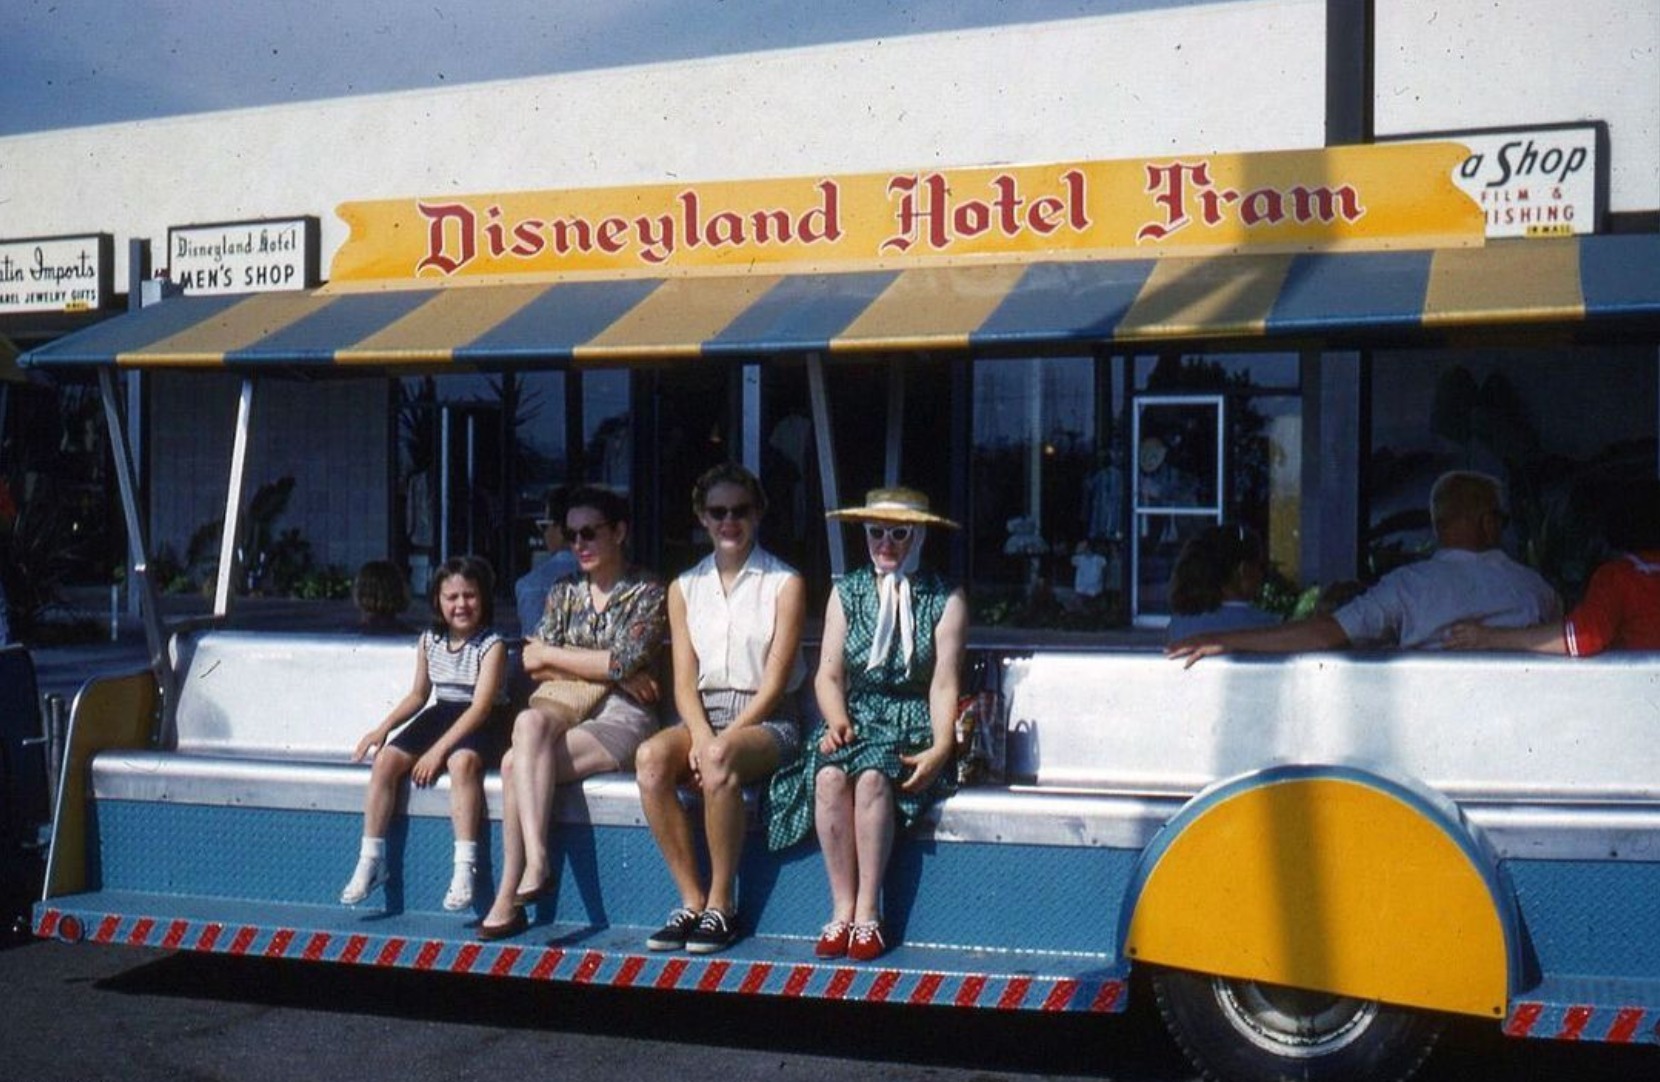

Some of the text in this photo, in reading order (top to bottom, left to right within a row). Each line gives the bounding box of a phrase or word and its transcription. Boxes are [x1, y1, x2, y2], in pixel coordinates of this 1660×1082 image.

[1486, 140, 1588, 187] Shop
[1481, 186, 1562, 202] FILM &
[416, 161, 1365, 277] Disneyland Hotel Tram
[1485, 204, 1575, 225] ISHING
[177, 228, 297, 263] Disneyland Hotel
[29, 246, 95, 287] Imports
[180, 263, 295, 290] MEN'S SHOP
[71, 289, 97, 301] GIFTS
